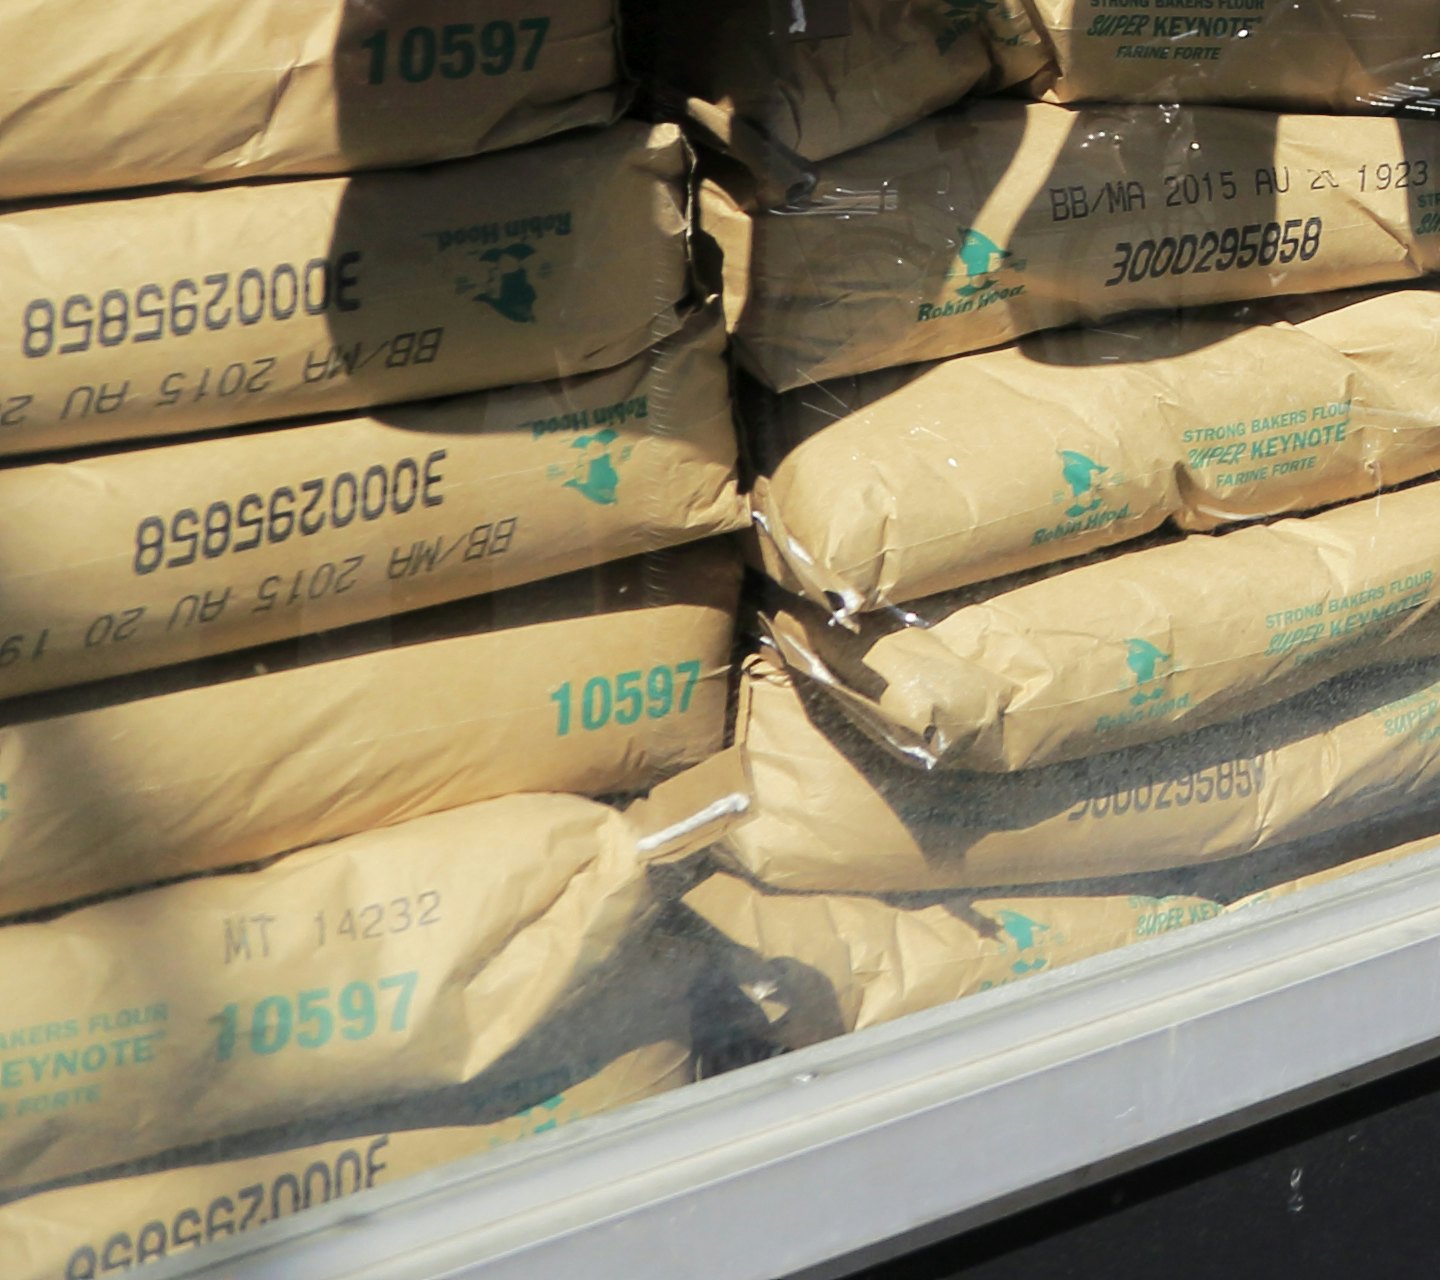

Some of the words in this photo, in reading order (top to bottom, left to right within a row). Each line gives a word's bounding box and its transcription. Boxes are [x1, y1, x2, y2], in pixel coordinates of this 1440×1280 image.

[362, 18, 551, 86] 10597
[1115, 45, 1170, 61] FARINE
[1172, 46, 1222, 61] FORTE
[1049, 180, 1147, 223] BB/MA
[1164, 171, 1238, 208] 2015
[1255, 165, 1291, 197] AU
[1357, 160, 1430, 193] 1923
[1103, 216, 1323, 288] 3000295858
[23, 250, 362, 359] 3000295858
[917, 296, 974, 323] Robin
[60, 379, 132, 419] AU
[157, 357, 276, 406] 2015
[1182, 424, 1247, 444] STRONG
[1250, 410, 1309, 434] BAKERS
[1250, 420, 1348, 462] KEYNOTE
[1215, 466, 1269, 490] FARINE
[1271, 455, 1318, 476] FORTE
[133, 449, 447, 576] 3000295858
[387, 516, 517, 580] BB/MA
[166, 584, 232, 632] AU
[251, 553, 366, 613] 2015
[1264, 607, 1323, 631] STRONG
[1327, 586, 1386, 614] BAKERS
[1389, 569, 1434, 594] FLOUR
[86, 605, 146, 649] 20
[551, 660, 703, 736] 10597
[223, 913, 277, 964] MT
[313, 889, 442, 947] 14232
[208, 970, 420, 1063] 10597
